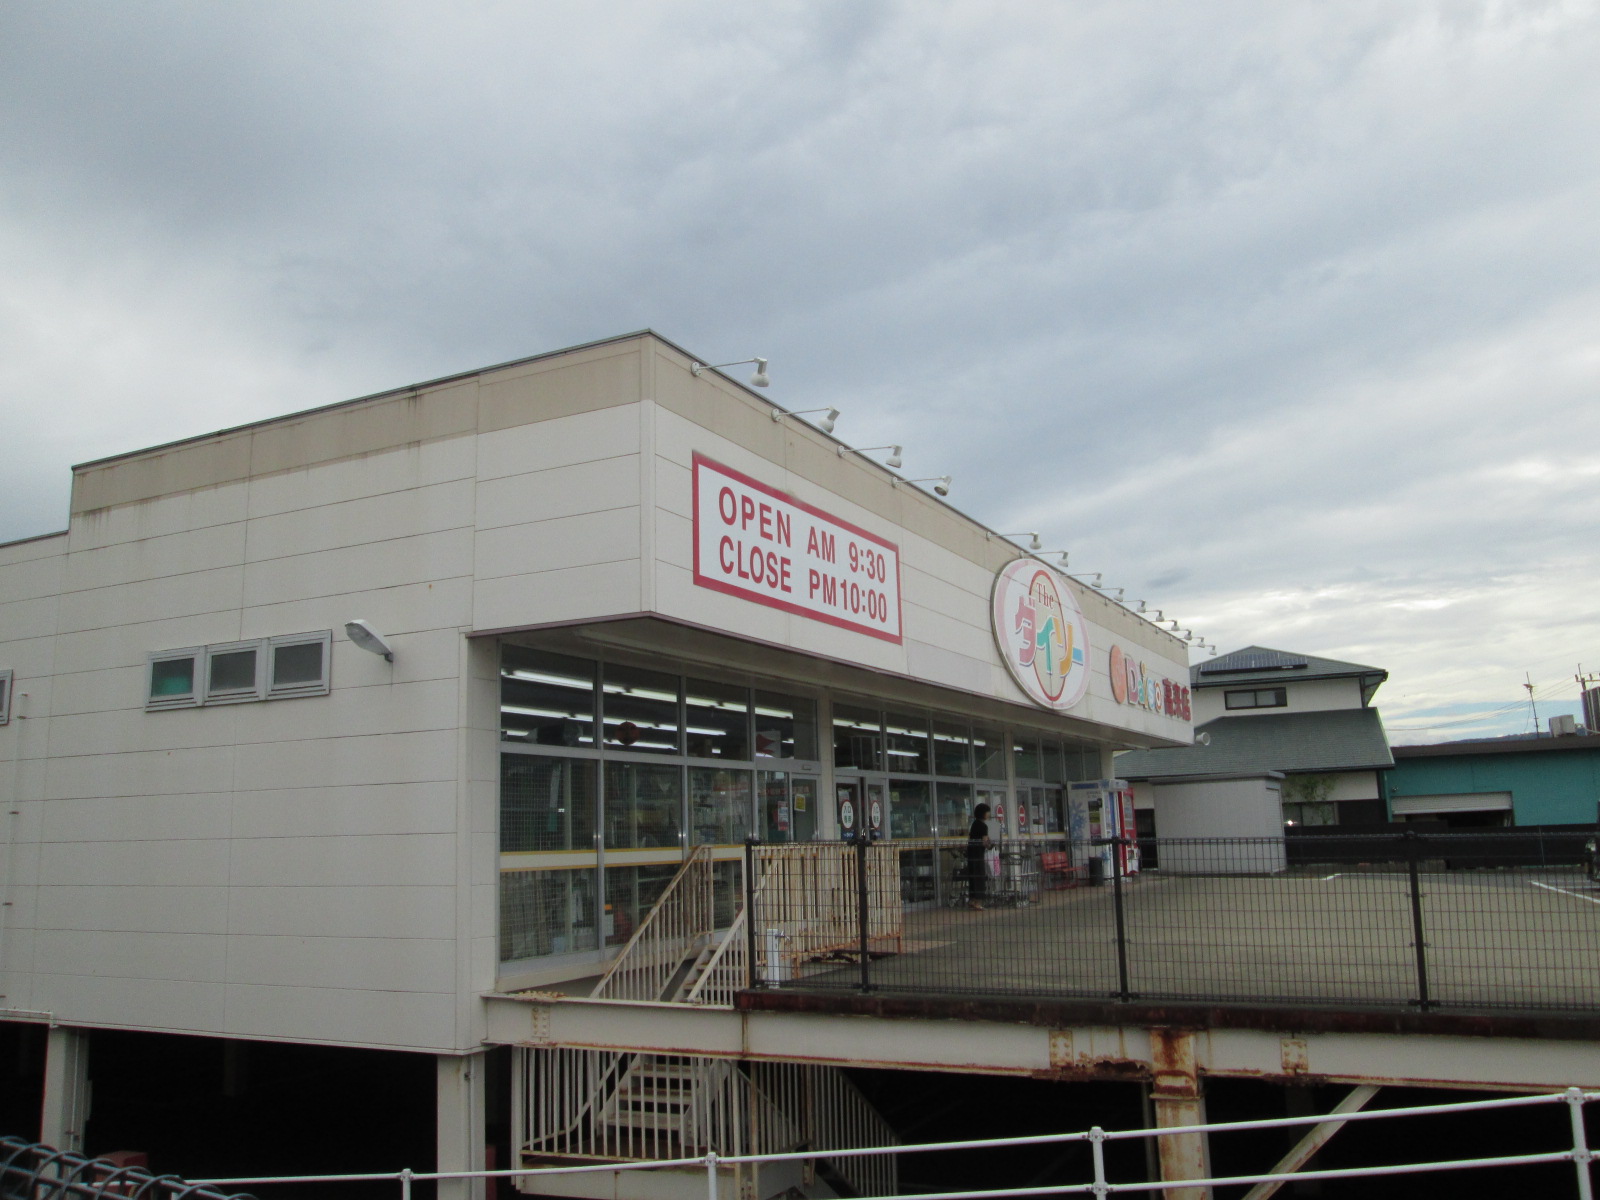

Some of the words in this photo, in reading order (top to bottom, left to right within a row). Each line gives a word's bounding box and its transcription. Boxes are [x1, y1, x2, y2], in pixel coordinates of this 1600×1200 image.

[719, 486, 792, 548] OPEN
[807, 526, 836, 564] AM
[849, 541, 886, 584] 9:30
[719, 535, 792, 594] CLOSE
[1037, 583, 1054, 609] The
[1014, 594, 1084, 678] ダイソー
[1125, 655, 1162, 711] Daiso
